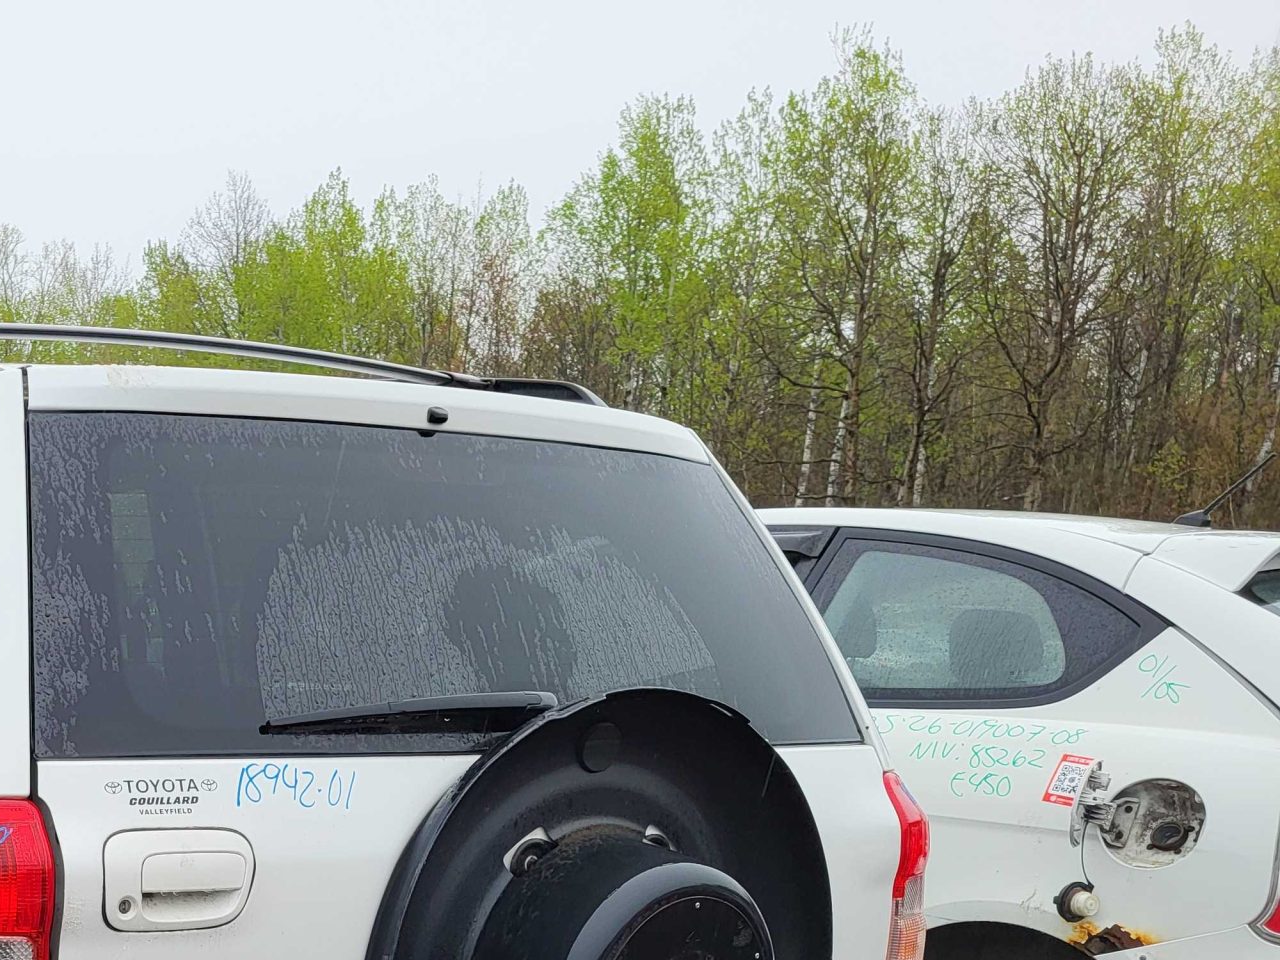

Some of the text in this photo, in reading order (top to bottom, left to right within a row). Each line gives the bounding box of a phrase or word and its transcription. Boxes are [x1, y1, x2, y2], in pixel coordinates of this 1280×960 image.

[969, 744, 1047, 769] 85262
[123, 778, 199, 794] TOYOTA
[129, 796, 199, 806] COUILLARD
[138, 807, 193, 816] VALLEYFIELD
